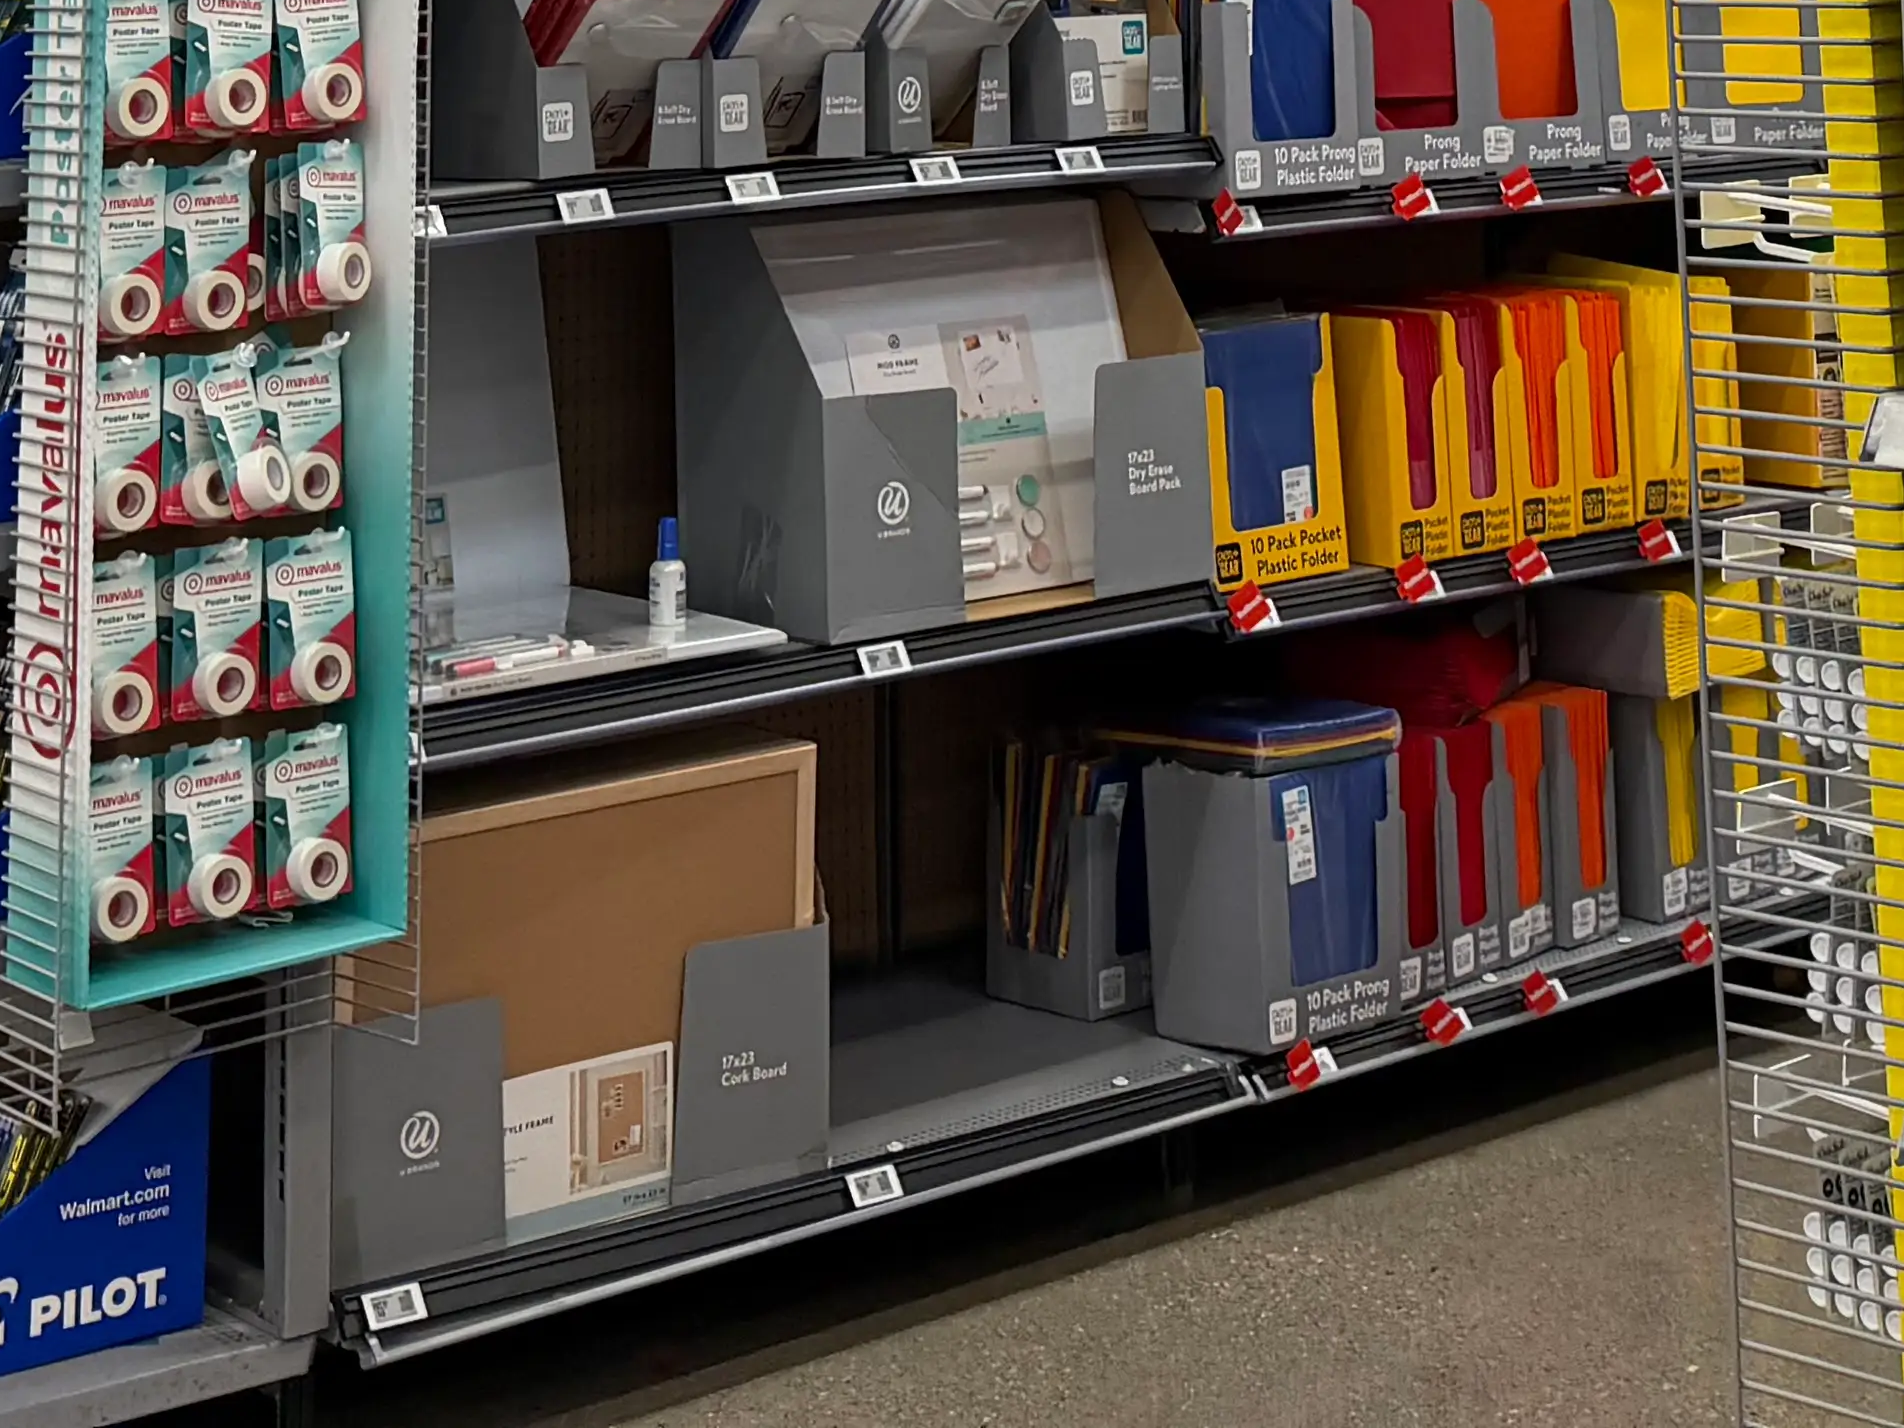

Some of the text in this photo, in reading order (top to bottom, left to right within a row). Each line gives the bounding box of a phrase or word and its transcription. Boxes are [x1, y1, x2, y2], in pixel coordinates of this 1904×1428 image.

[1128, 449, 1154, 464] 17x23
[1128, 464, 1174, 481] Dry Erase
[1130, 476, 1181, 495] Board Pack
[721, 1051, 755, 1070] 17x23
[721, 1061, 787, 1086] Cork Board
[143, 1163, 171, 1180] Visit
[59, 1181, 170, 1221] Walmart.com
[116, 1204, 169, 1226] for more
[29, 1266, 165, 1339] PILOT
